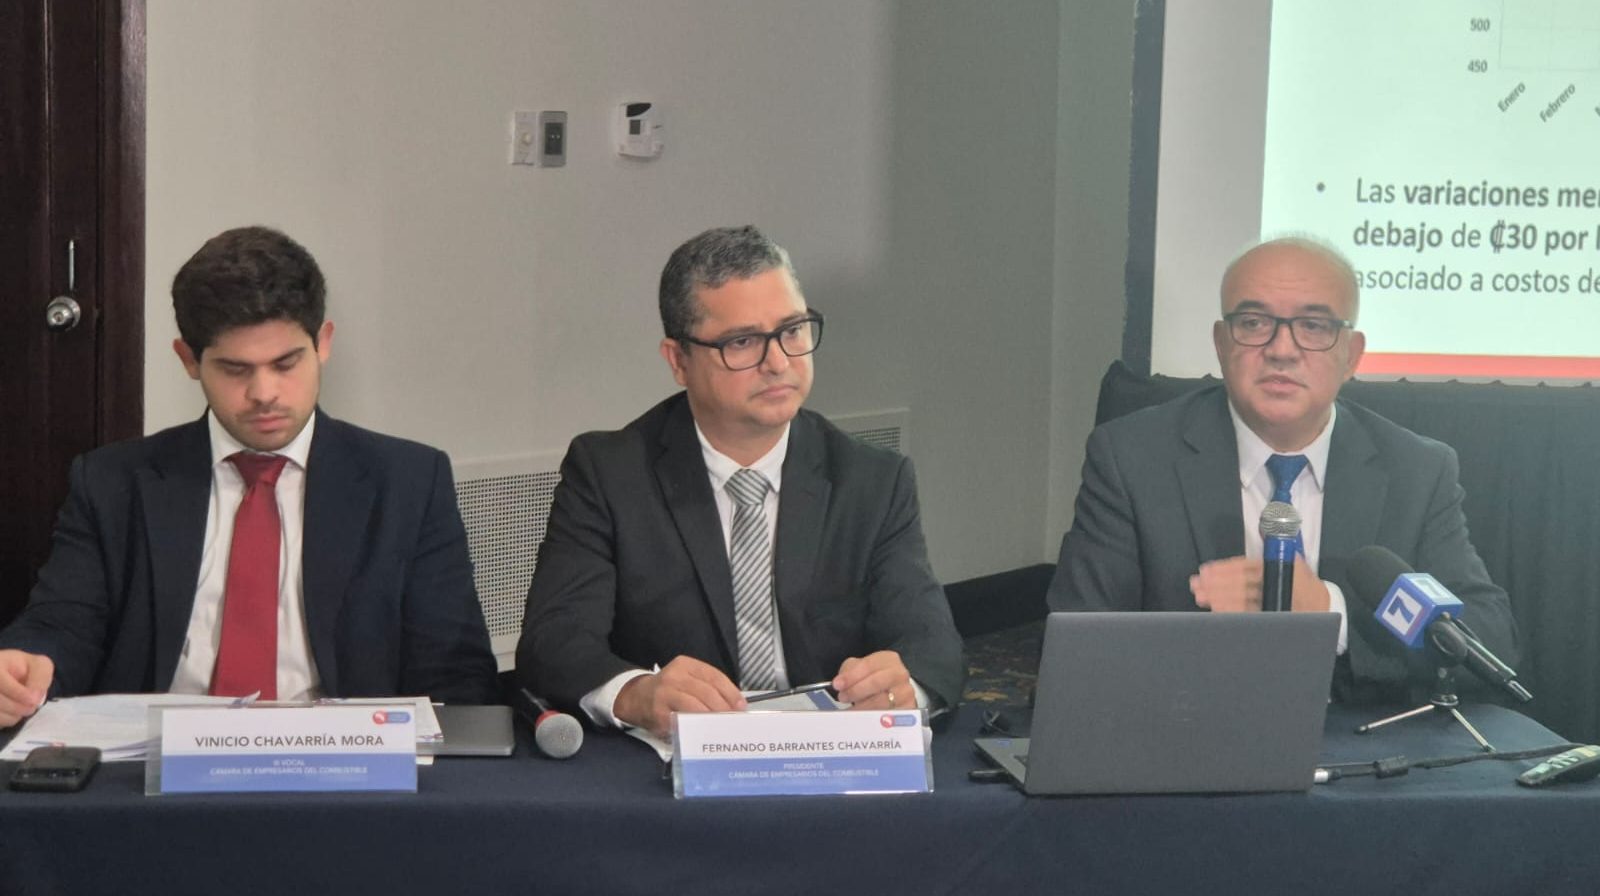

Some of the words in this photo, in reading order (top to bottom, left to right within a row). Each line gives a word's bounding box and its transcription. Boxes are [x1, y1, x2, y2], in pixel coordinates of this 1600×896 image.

[1470, 18, 1490, 31] 500
[1467, 60, 1488, 73] 450
[1497, 82, 1526, 112] Enero
[1539, 84, 1576, 123] Febrero
[1356, 178, 1396, 204] Las
[1403, 180, 1549, 207] variaciones
[1353, 220, 1443, 252] debajo
[1451, 223, 1481, 247] de
[1544, 230, 1589, 256] por
[1470, 273, 1483, 290] a
[1492, 269, 1570, 294] costos
[1388, 595, 1415, 624] 7
[195, 736, 250, 748] VINICIO
[254, 733, 336, 747] CHAVARRÍA
[341, 735, 384, 747] MORA
[702, 743, 766, 753] FERNANDO
[769, 741, 834, 752] BARRANTES
[837, 738, 902, 751] CHAVARRÍA
